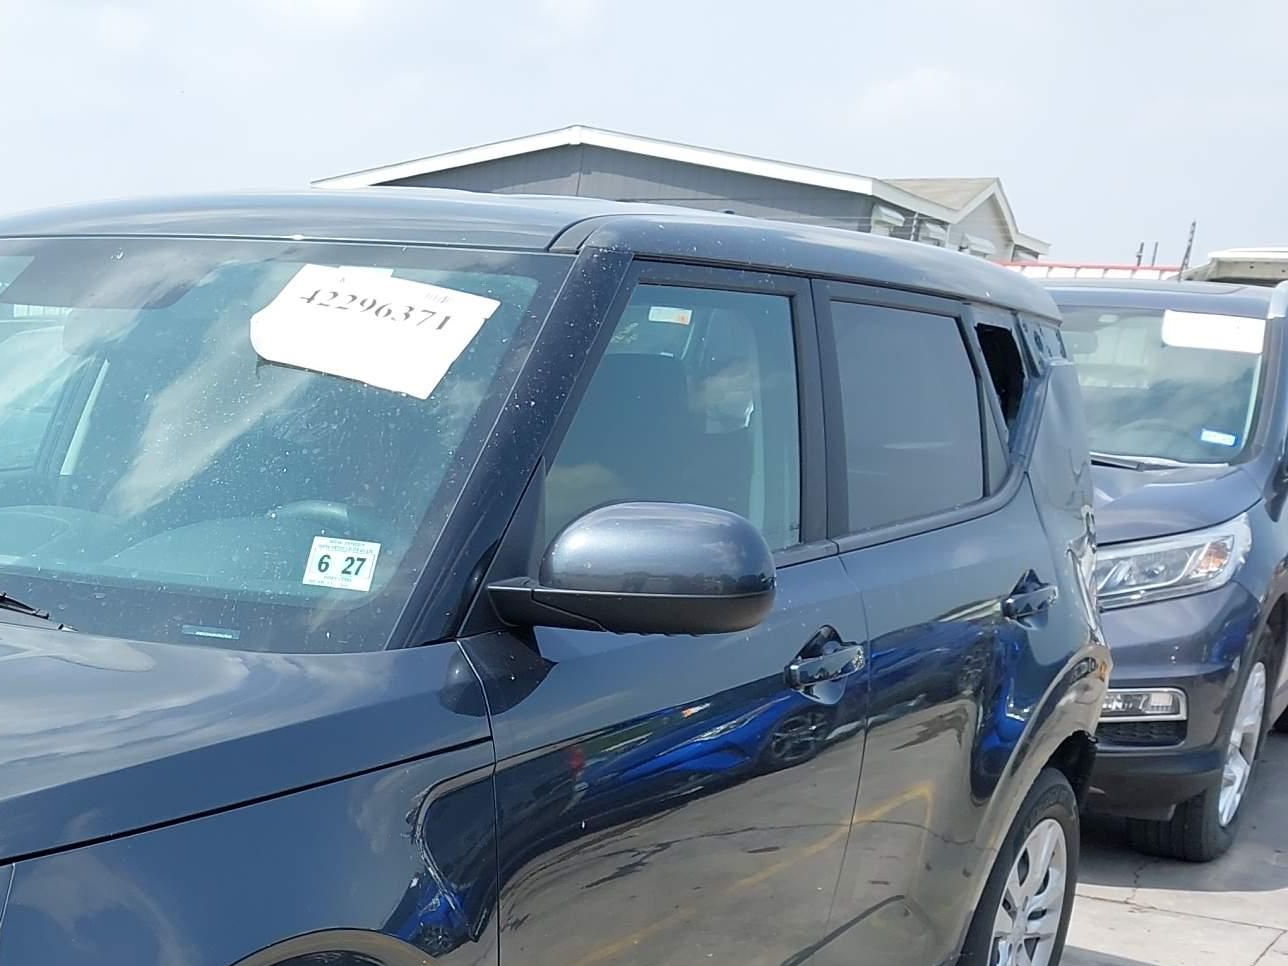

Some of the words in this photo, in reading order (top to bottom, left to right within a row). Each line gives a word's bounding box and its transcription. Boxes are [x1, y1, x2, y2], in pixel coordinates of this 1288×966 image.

[300, 289, 452, 331] 42296371
[317, 554, 332, 573] 6
[341, 556, 368, 576] 27
